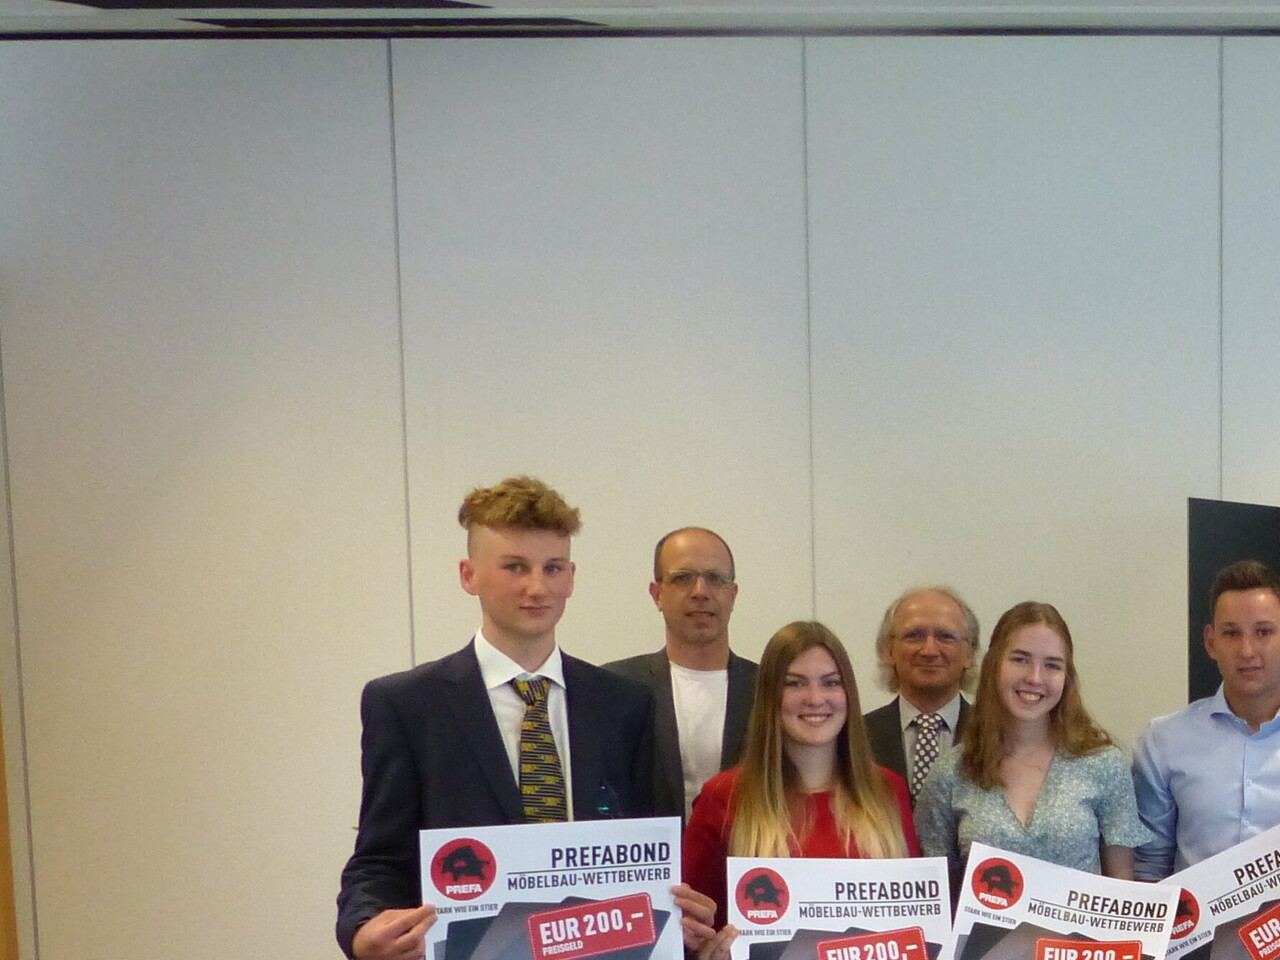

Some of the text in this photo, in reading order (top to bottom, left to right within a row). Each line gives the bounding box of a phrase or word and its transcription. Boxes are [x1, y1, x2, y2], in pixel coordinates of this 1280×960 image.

[551, 842, 671, 868] PREFABOND
[508, 867, 671, 890] MÖBELBAU-WETTBEWERB
[445, 883, 482, 895] PREFA
[834, 880, 940, 900] PREFABOND
[979, 892, 1008, 907] PREFA
[1067, 890, 1168, 918] PREFABOND
[747, 909, 778, 919] PREFA
[799, 903, 941, 918] MÖBELBAU-WETTBEWERB
[1027, 901, 1165, 933] MÖBELBAU-WETTBEWERB
[539, 917, 582, 945] EUR
[542, 940, 584, 956] PREISGELD
